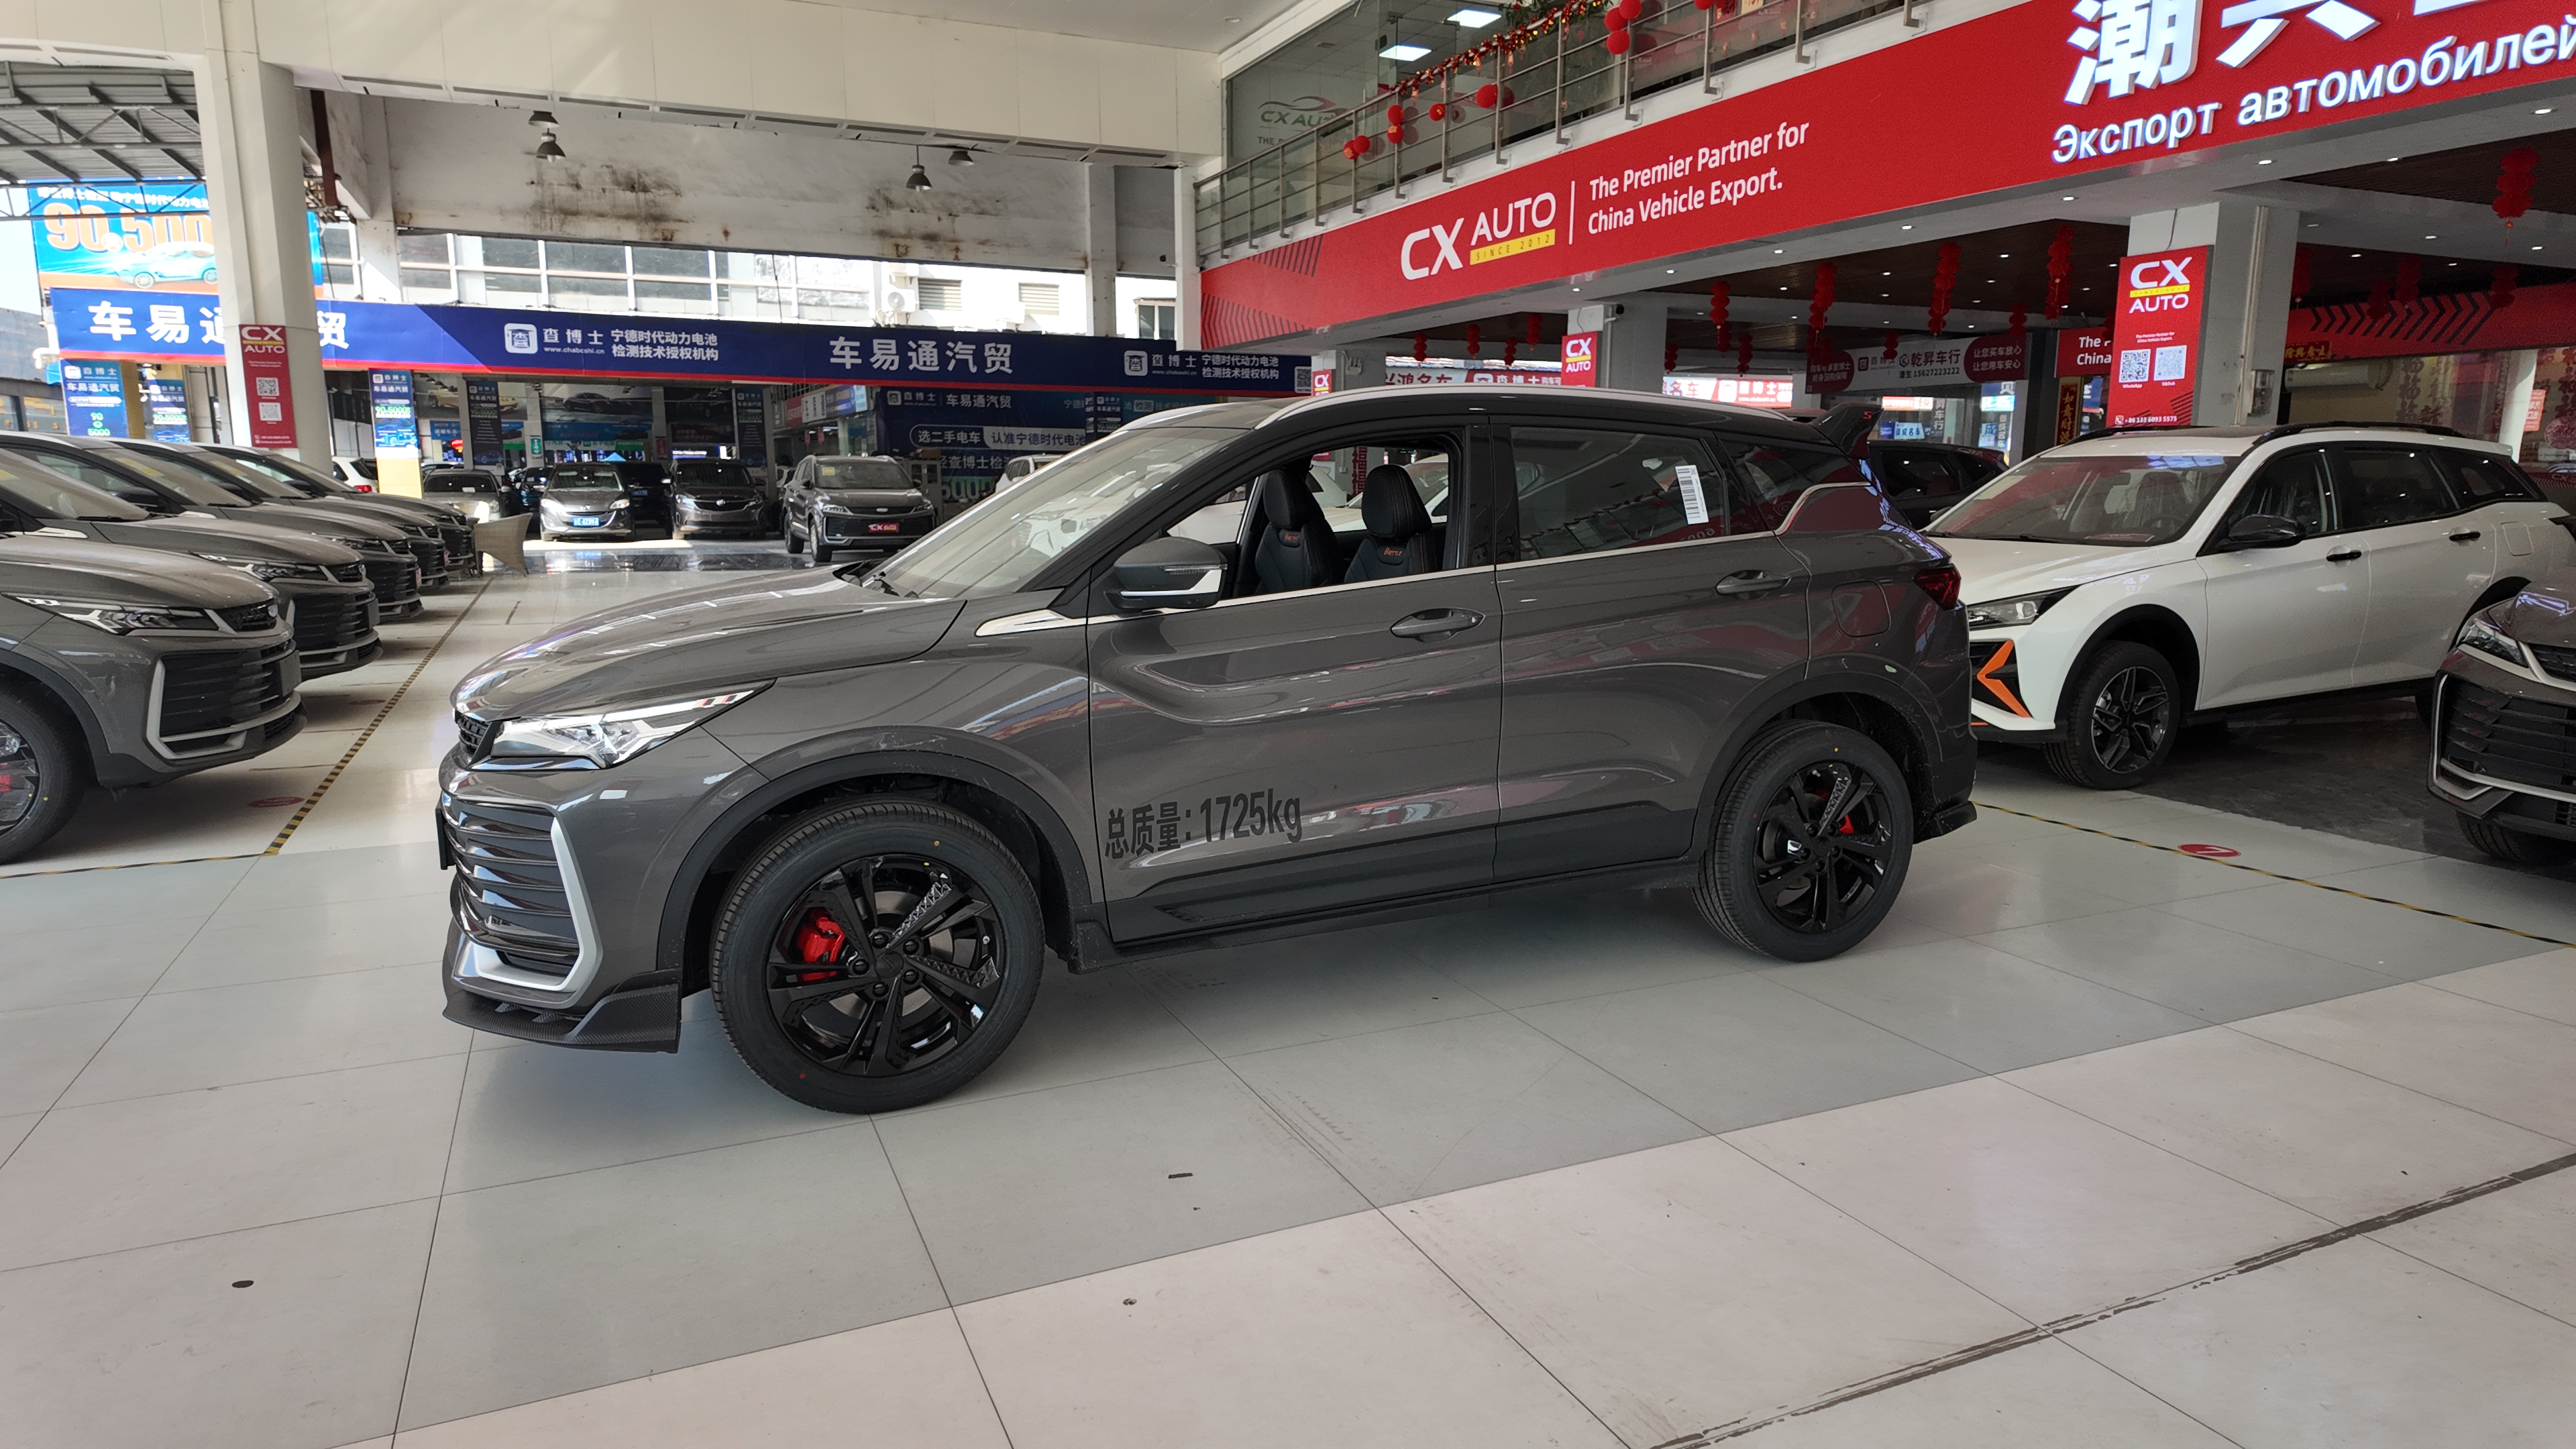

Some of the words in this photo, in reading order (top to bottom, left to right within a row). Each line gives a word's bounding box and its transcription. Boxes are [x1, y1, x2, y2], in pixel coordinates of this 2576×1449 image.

[1260, 110, 1291, 125] CX
[1258, 136, 1274, 146] THE
[2052, 102, 2222, 164] Экспорт
[1589, 176, 1619, 201] The
[1623, 155, 1693, 192] Premier
[1697, 132, 1772, 172] Partner
[1777, 121, 1810, 150] for
[1588, 207, 1633, 234] China
[1639, 186, 1705, 222] Vehicle
[1710, 167, 1782, 206] Export.
[1401, 217, 1464, 280] CX
[1470, 192, 1556, 246] AUTO
[1476, 245, 1510, 261] SINCE
[1520, 234, 1550, 250] 2012
[2131, 257, 2193, 289] CX
[2129, 293, 2189, 314] AUTO
[241, 326, 284, 341] CX
[543, 327, 603, 345] 查博士
[611, 328, 718, 346] 宁德时代动力电池
[2078, 335, 2100, 349] The
[244, 345, 285, 354] AUTO
[612, 344, 719, 362] 检测技术授权机构
[829, 336, 1013, 374] 车易通汽贸
[1566, 337, 1592, 358] CX
[1152, 354, 1197, 368] 查博士
[1201, 354, 1279, 367] 宁德时代动力电池
[1565, 360, 1592, 373] AUTO
[1911, 349, 1961, 367] 乾昇车行
[2076, 352, 2112, 366] China
[1202, 366, 1279, 380] 检测技术授权机构
[1314, 374, 1330, 388] CX
[66, 382, 120, 392] 车易通汽贸
[904, 391, 936, 402] 查博士
[946, 394, 1012, 409] 车易通汽贸
[1863, 411, 1872, 419] S
[918, 430, 981, 444] 选二手电车
[991, 431, 1087, 446] 认准宁德时代电池
